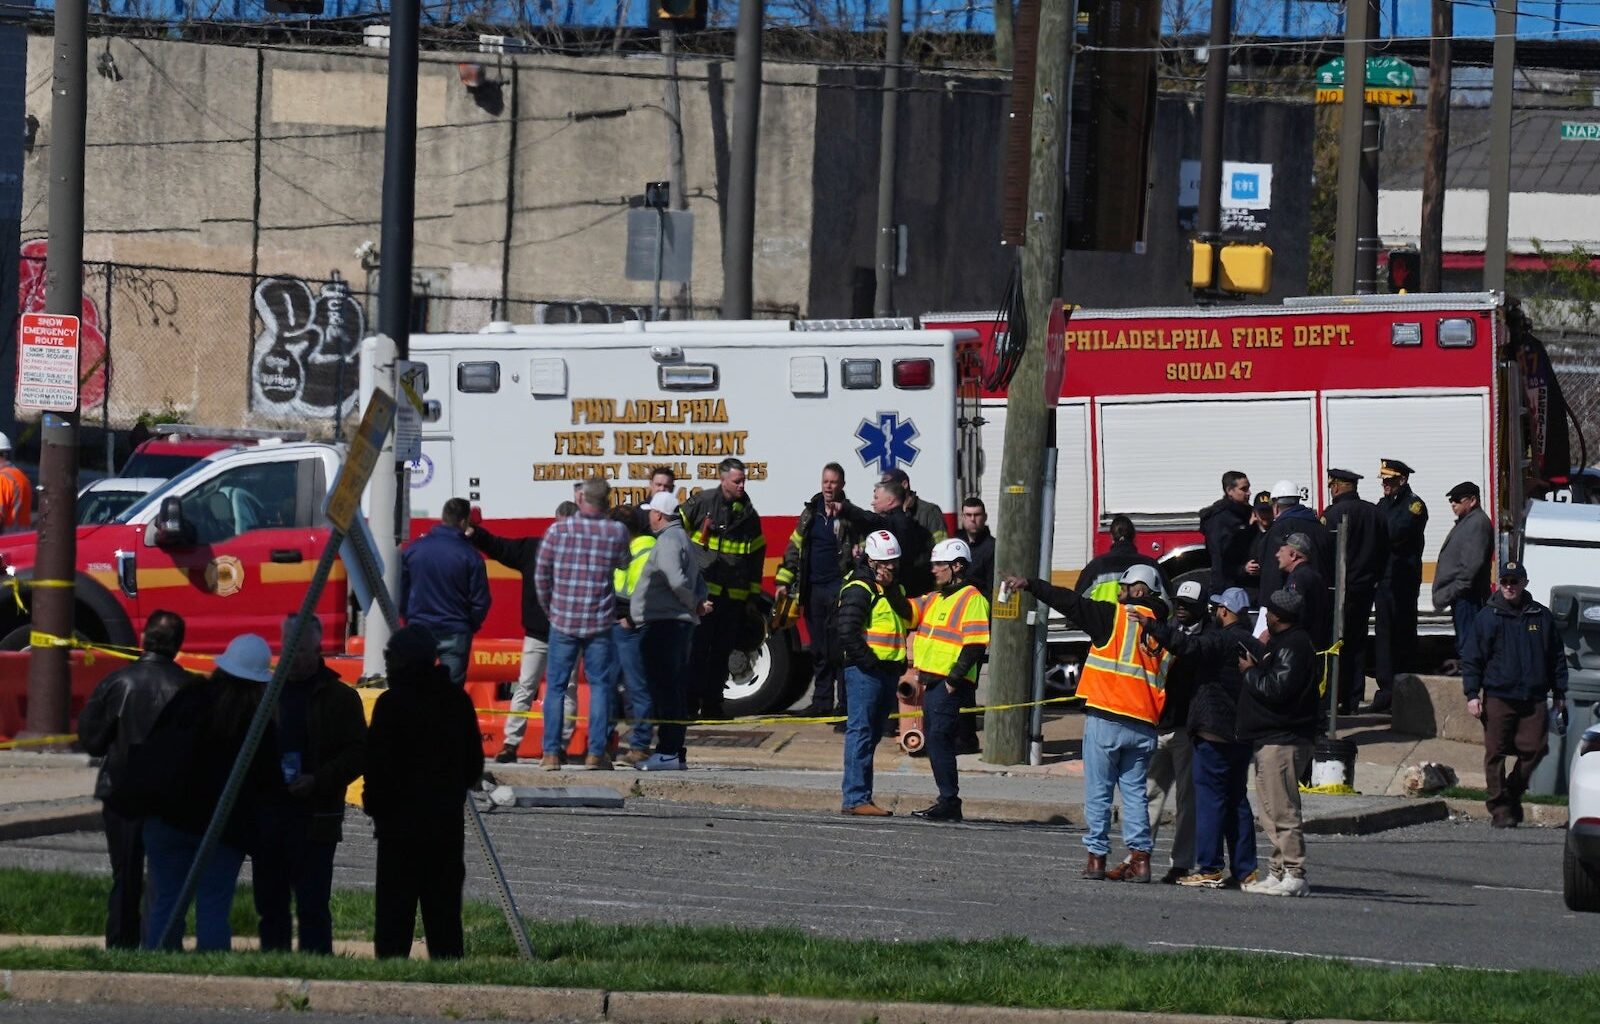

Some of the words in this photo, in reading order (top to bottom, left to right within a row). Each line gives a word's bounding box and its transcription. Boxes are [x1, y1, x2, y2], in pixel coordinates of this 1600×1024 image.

[1320, 90, 1338, 101] NO
[23, 326, 76, 336] EMERGENCY
[37, 317, 63, 327] SNOW
[34, 335, 65, 345] ROUTE
[1064, 329, 1222, 351] PHILADELPHIA
[1231, 327, 1284, 348] FIRE
[1293, 324, 1355, 347] DEPT.
[1166, 362, 1227, 382] SQUAD
[1229, 361, 1253, 379] 47
[571, 399, 729, 424] PHILADELPHIA
[554, 431, 605, 456] FIRE
[614, 430, 748, 456] DEPARTMENT
[533, 463, 622, 481] EMERGENCY
